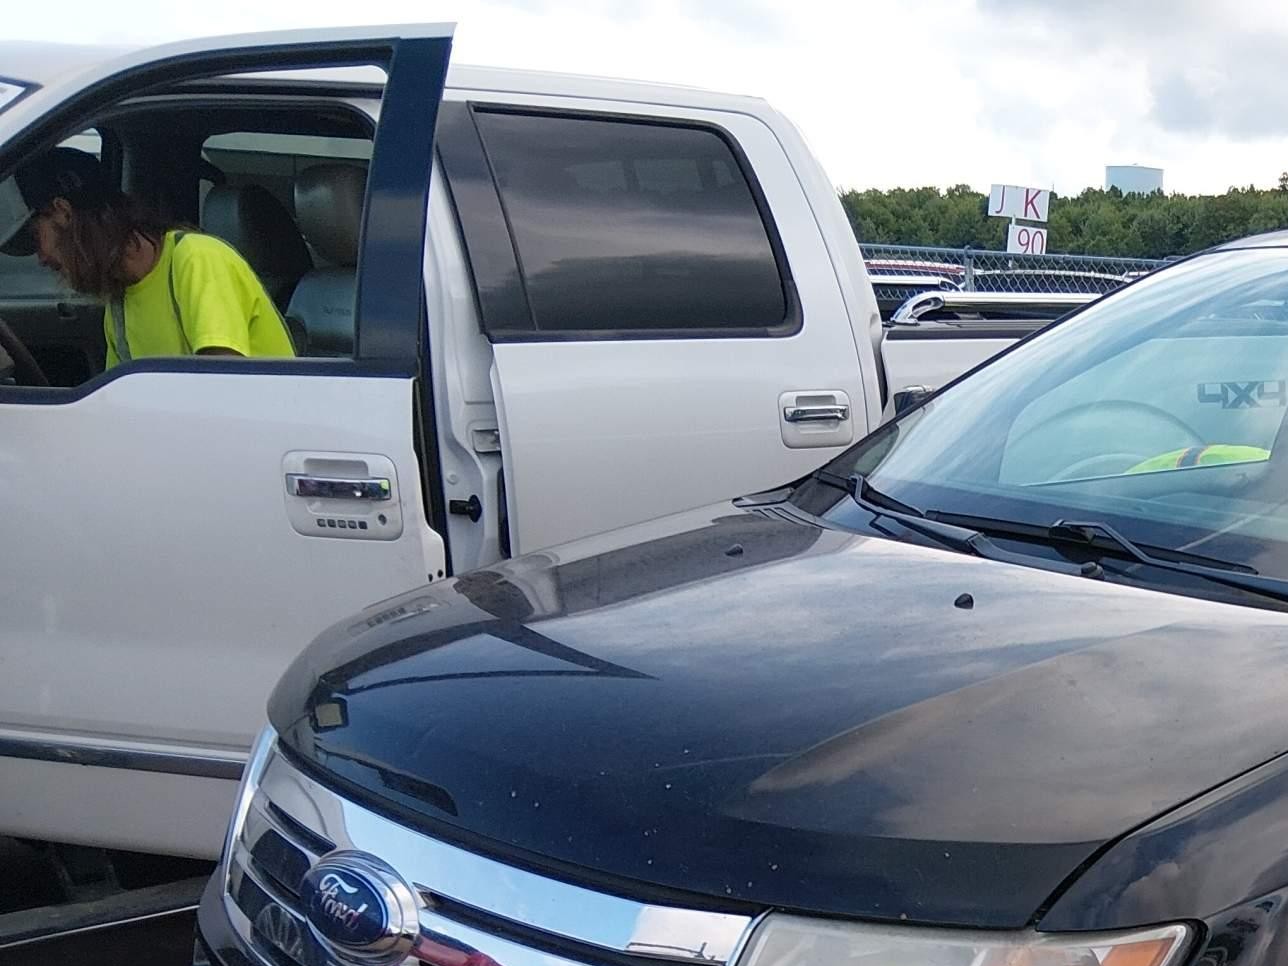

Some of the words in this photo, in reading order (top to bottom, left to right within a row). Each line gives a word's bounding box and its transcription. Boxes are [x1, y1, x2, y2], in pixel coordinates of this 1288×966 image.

[994, 185, 1005, 214] J
[1024, 188, 1041, 219] K
[1018, 228, 1044, 254] 90
[314, 873, 369, 930] Ford
